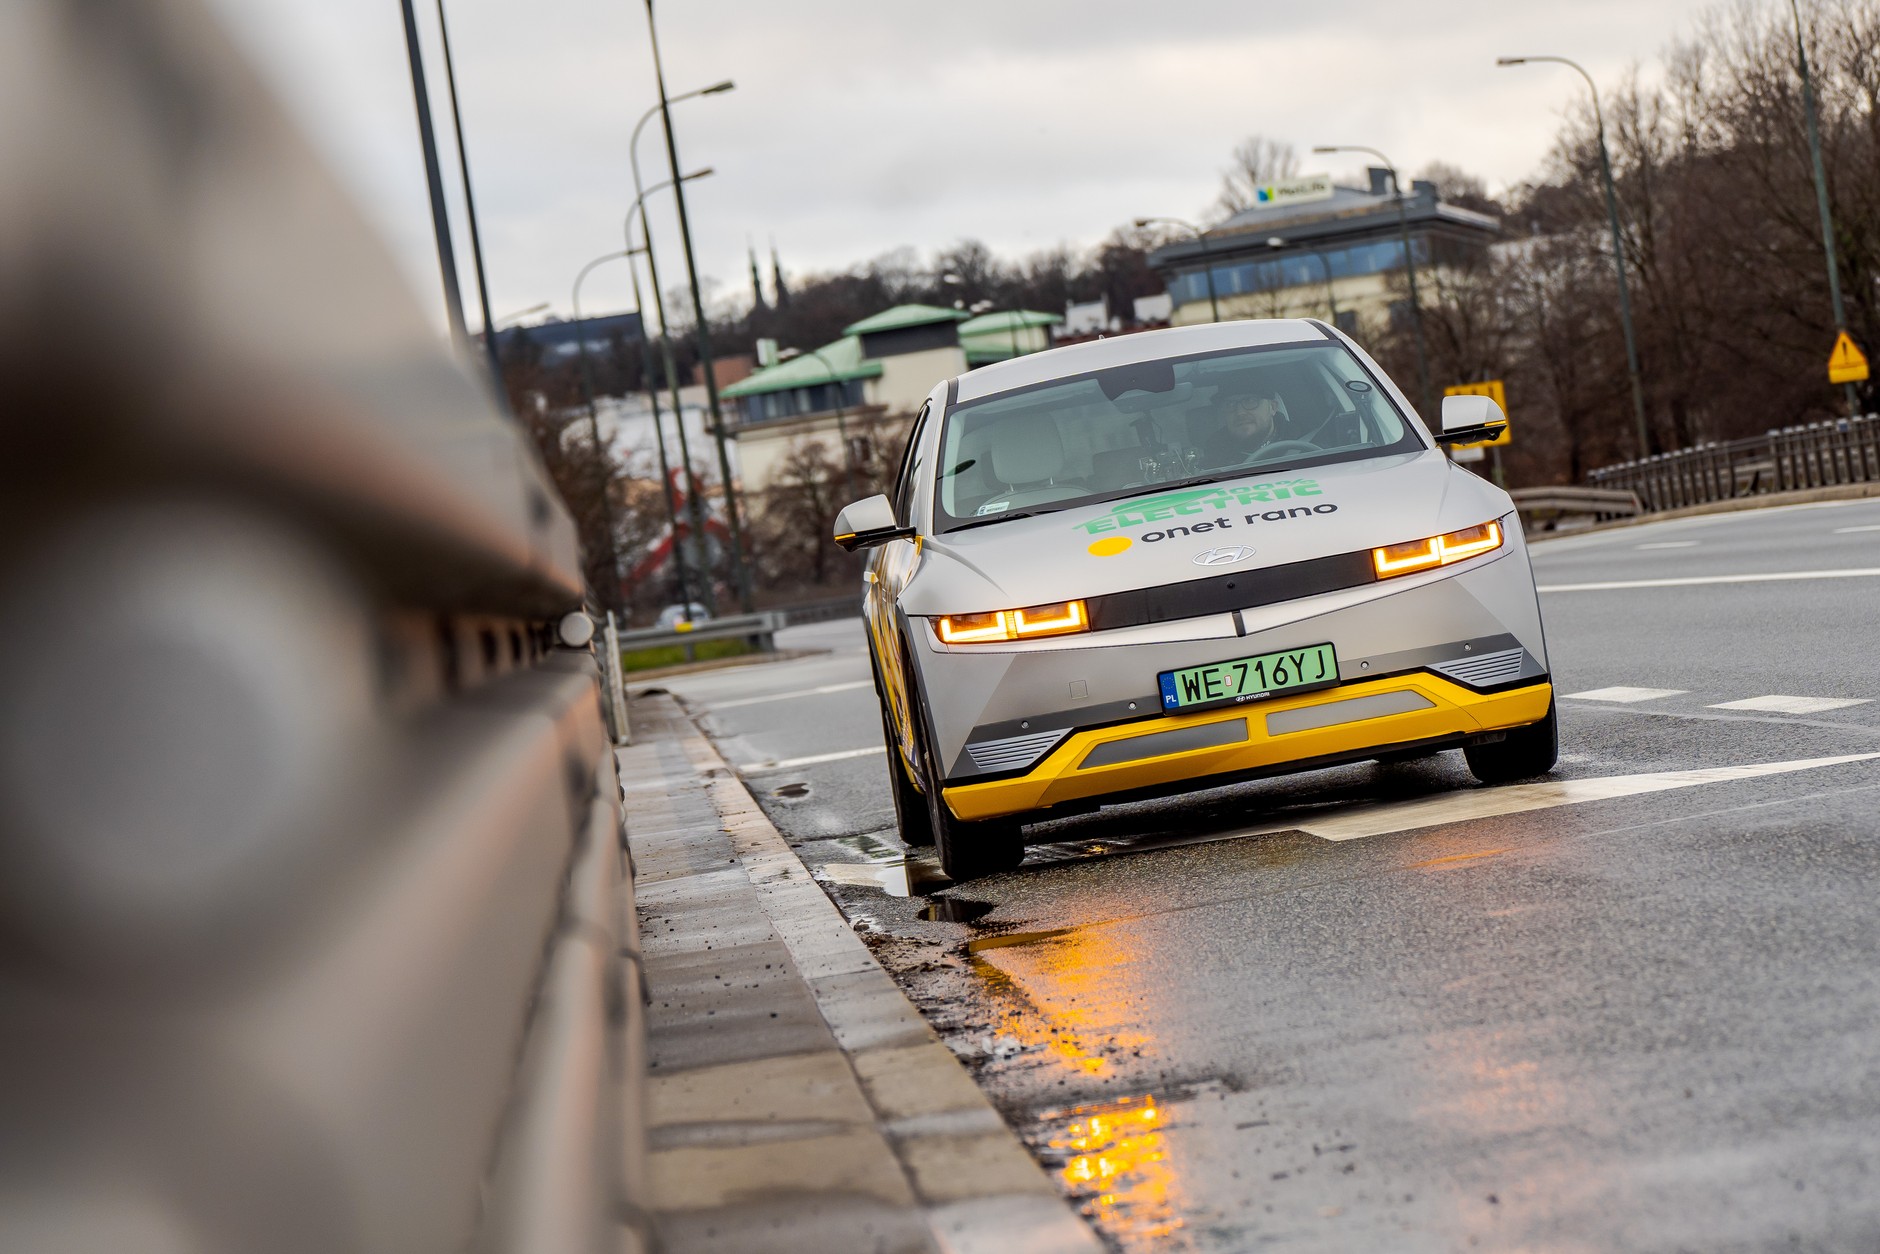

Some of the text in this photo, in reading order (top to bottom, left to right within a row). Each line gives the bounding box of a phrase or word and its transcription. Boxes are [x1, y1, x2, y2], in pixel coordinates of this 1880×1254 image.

[1083, 483, 1323, 535] ELECTRIC
[1141, 503, 1338, 543] onet rano
[1165, 694, 1177, 704] PL
